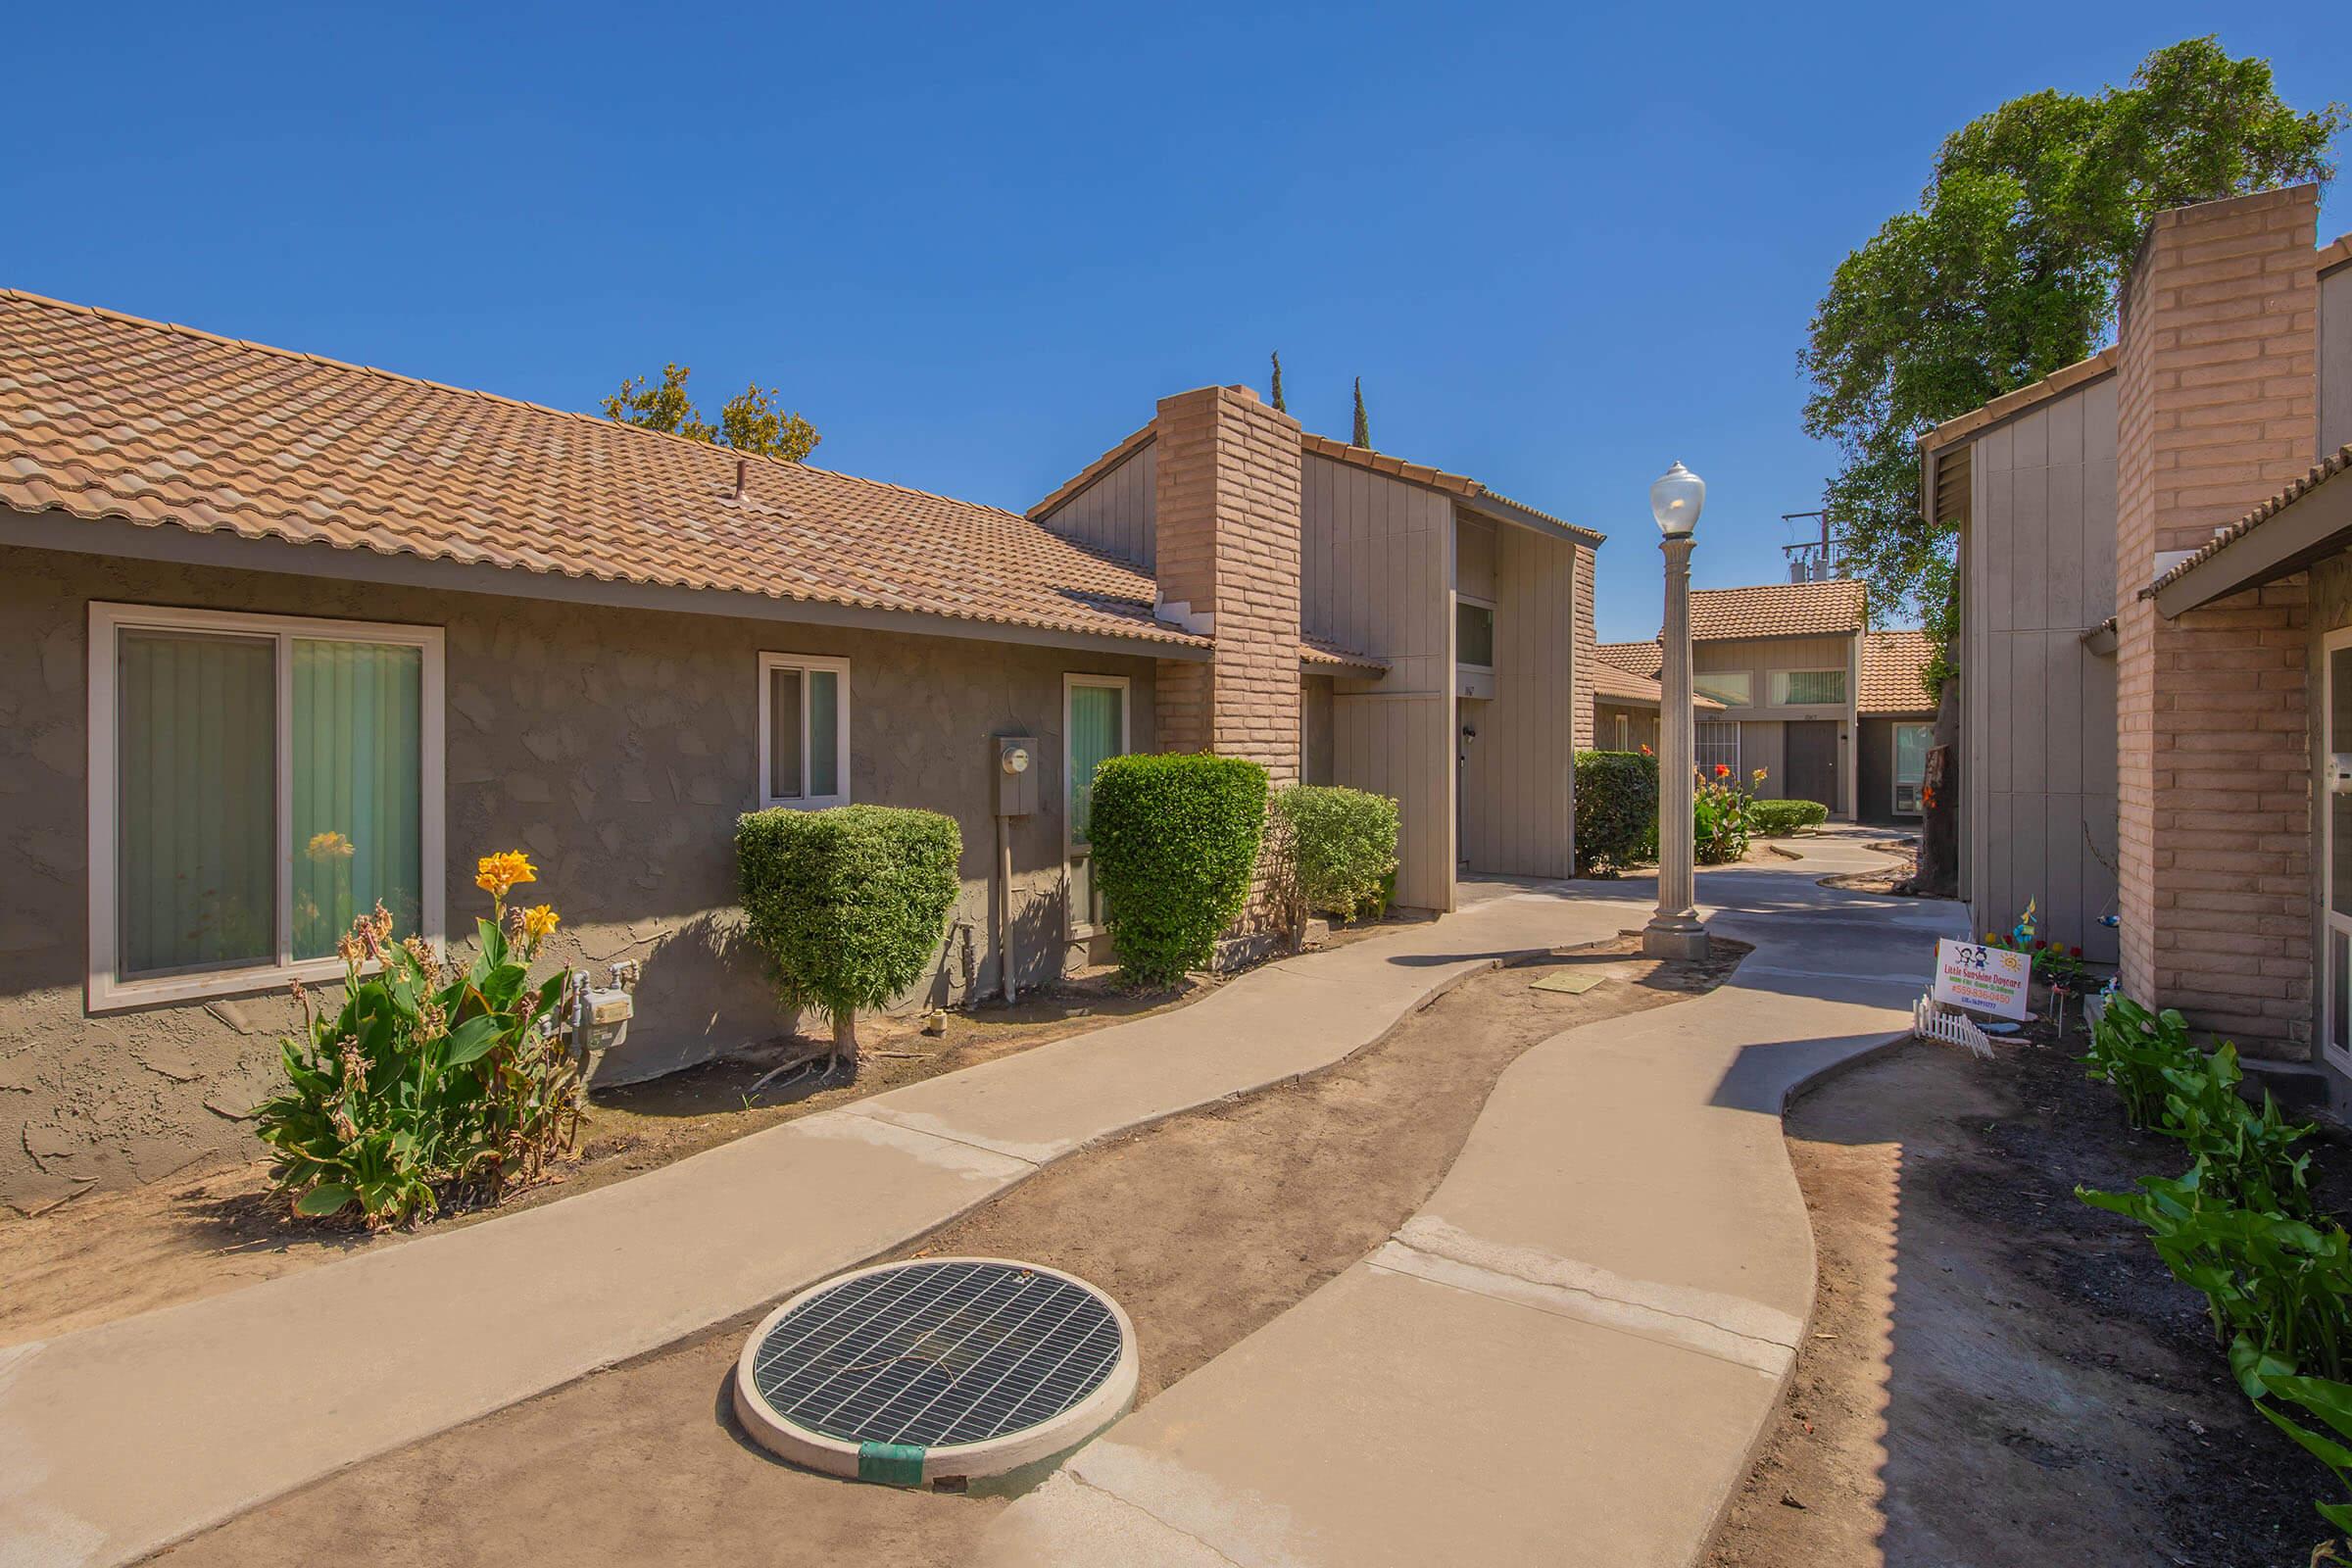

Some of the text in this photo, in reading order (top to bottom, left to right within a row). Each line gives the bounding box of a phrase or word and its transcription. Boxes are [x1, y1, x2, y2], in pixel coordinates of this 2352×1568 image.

[1944, 964, 2021, 989] Little Sunshine Daycare
